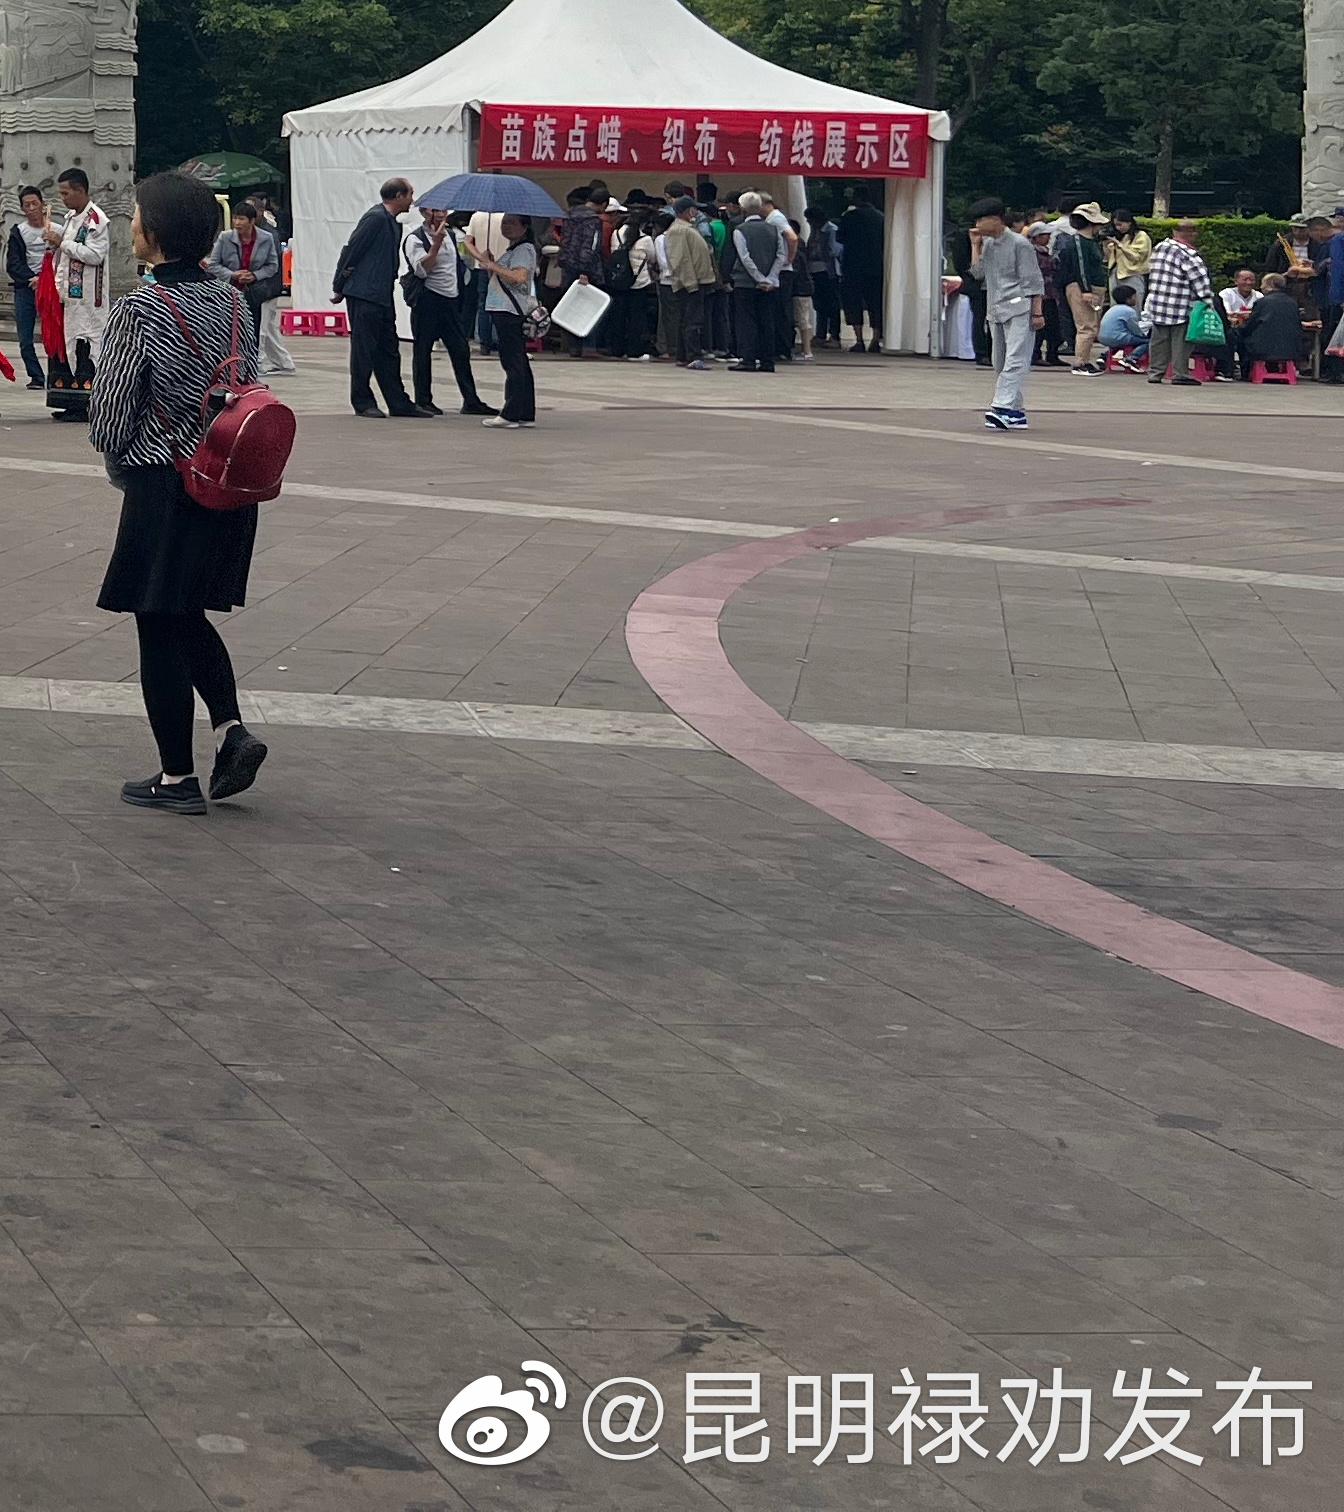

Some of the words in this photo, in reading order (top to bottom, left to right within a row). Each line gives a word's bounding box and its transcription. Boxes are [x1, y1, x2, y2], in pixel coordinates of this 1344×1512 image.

[500, 113, 911, 170] 苗族点蜡、织布、纺线展示区
